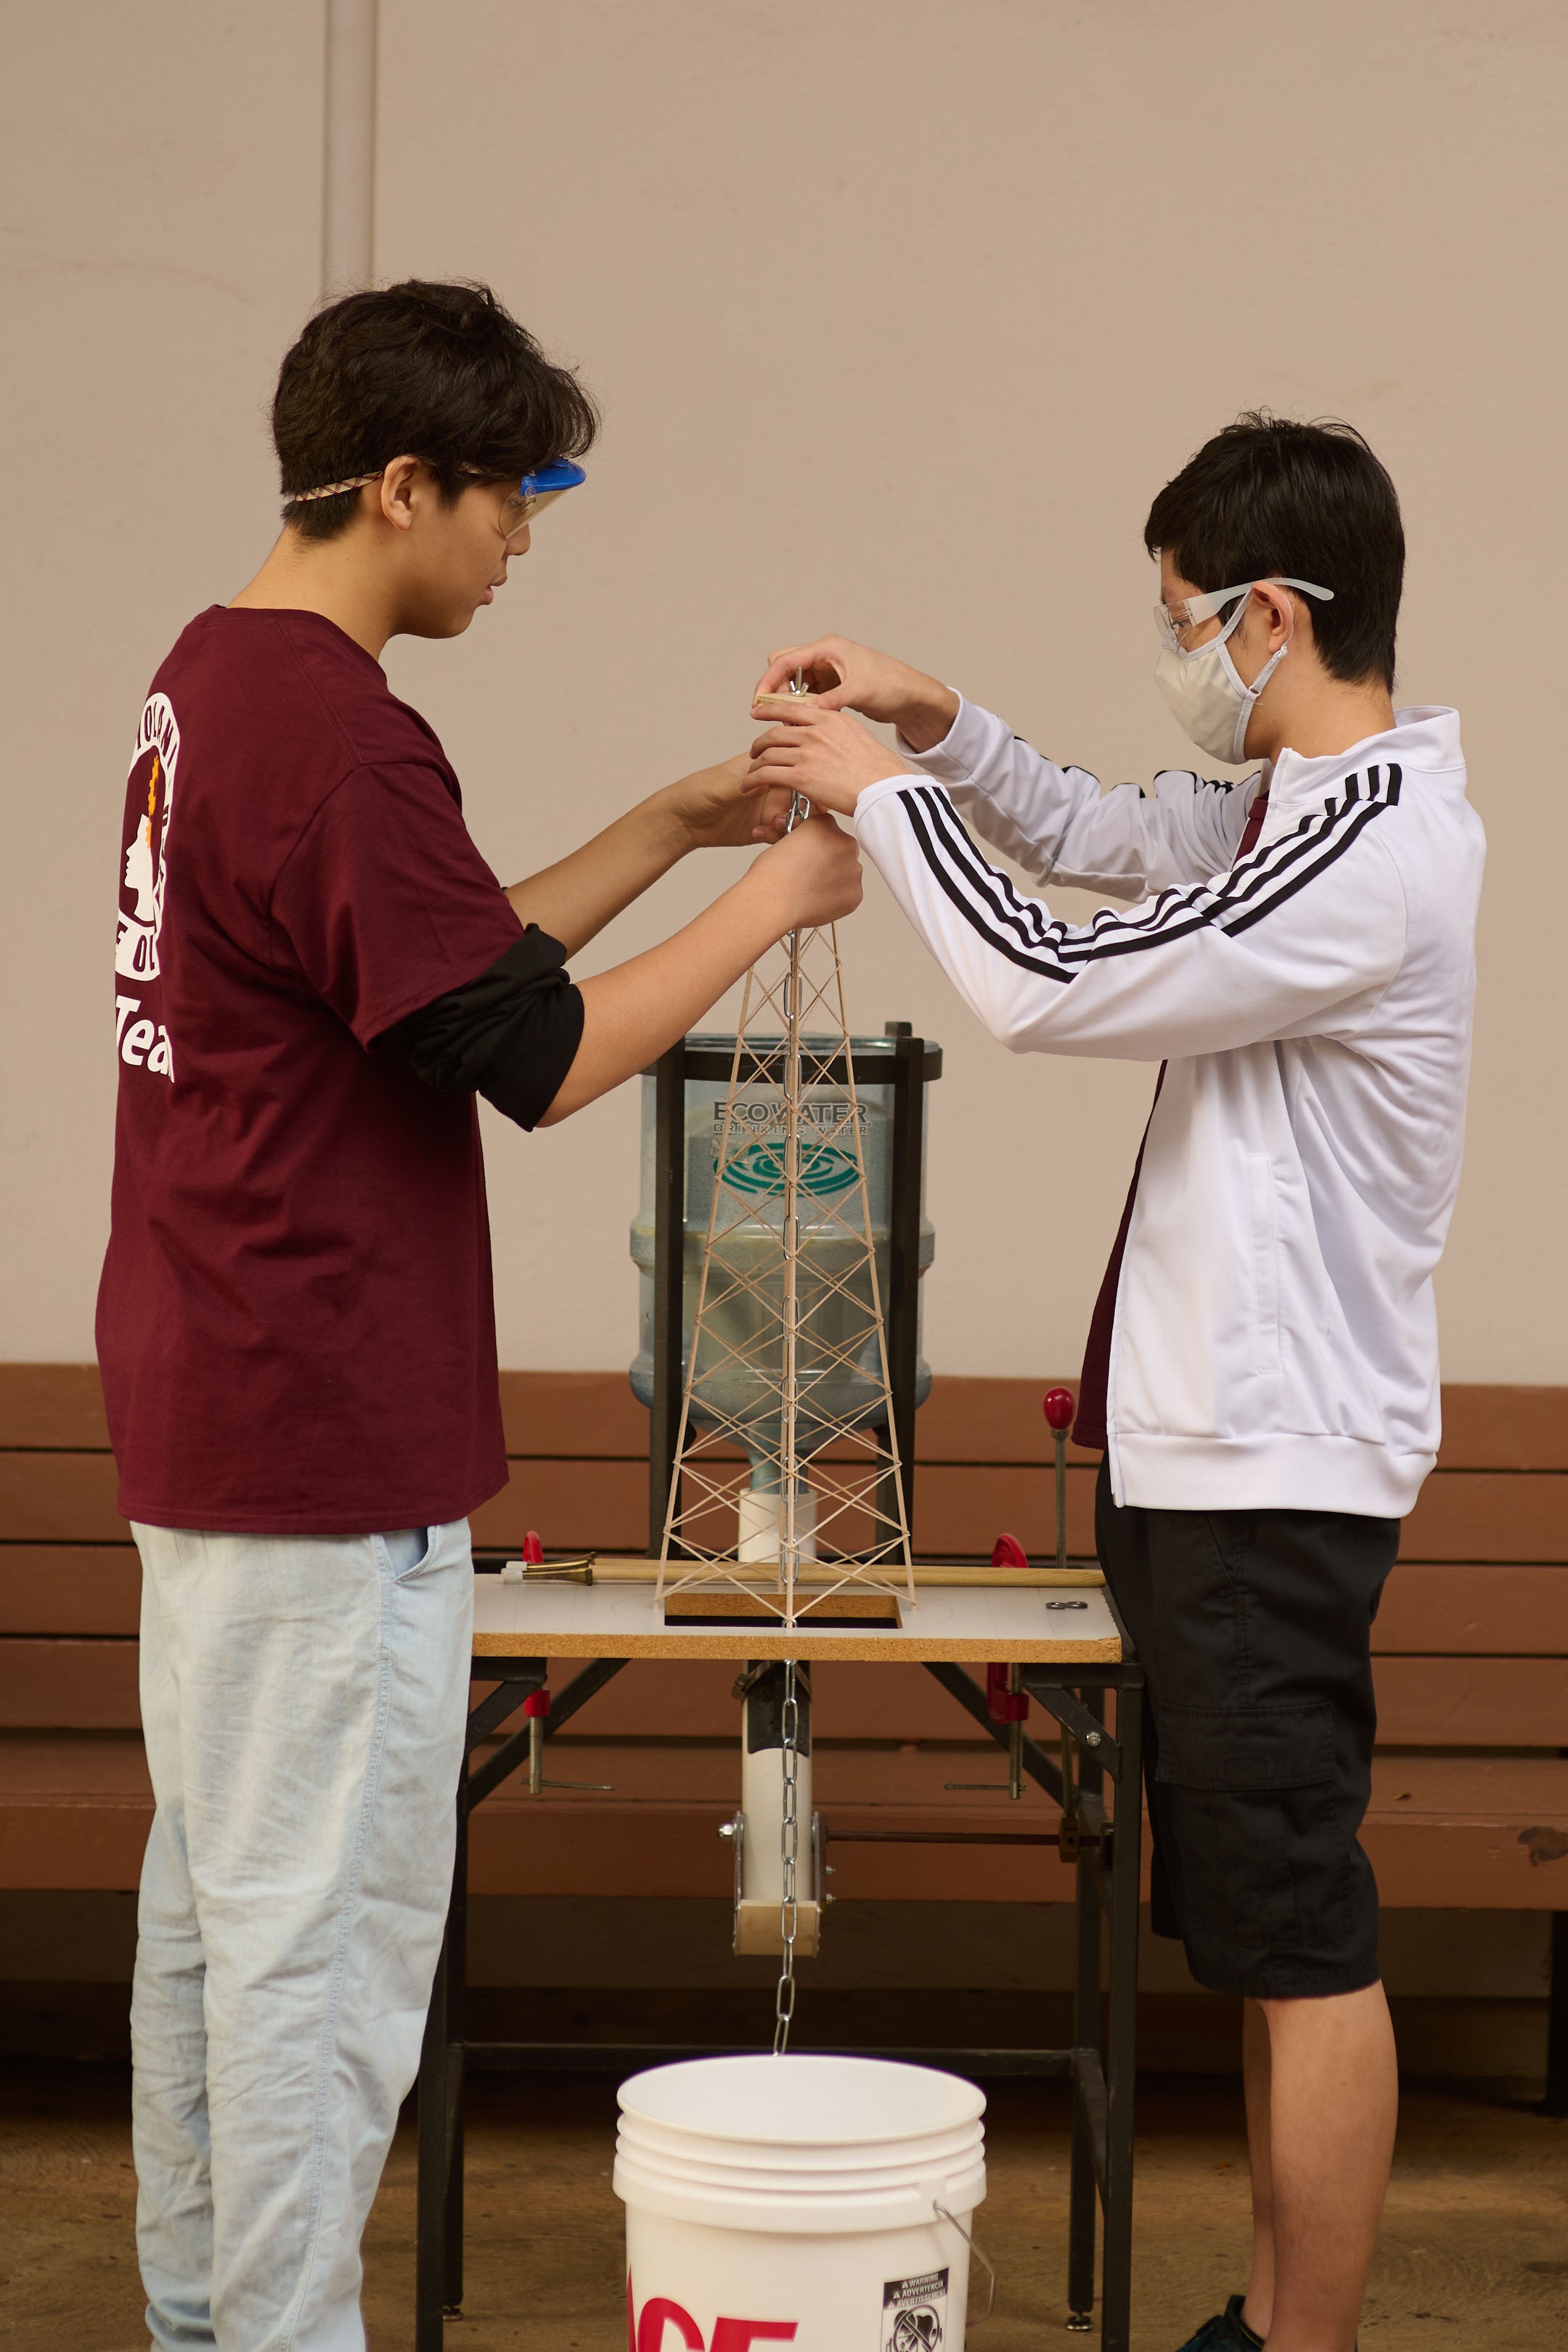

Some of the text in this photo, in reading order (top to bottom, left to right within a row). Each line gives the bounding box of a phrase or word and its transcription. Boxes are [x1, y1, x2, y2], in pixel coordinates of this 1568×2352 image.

[115, 995, 175, 1082] Tea
[714, 1101, 869, 1124] ECOWATER
[816, 1125, 869, 1135] WATER
[902, 2280, 944, 2298] ADVERTENCIA
[908, 2274, 939, 2287] WARNING
[897, 2288, 947, 2308] AVERTISSEMENT
